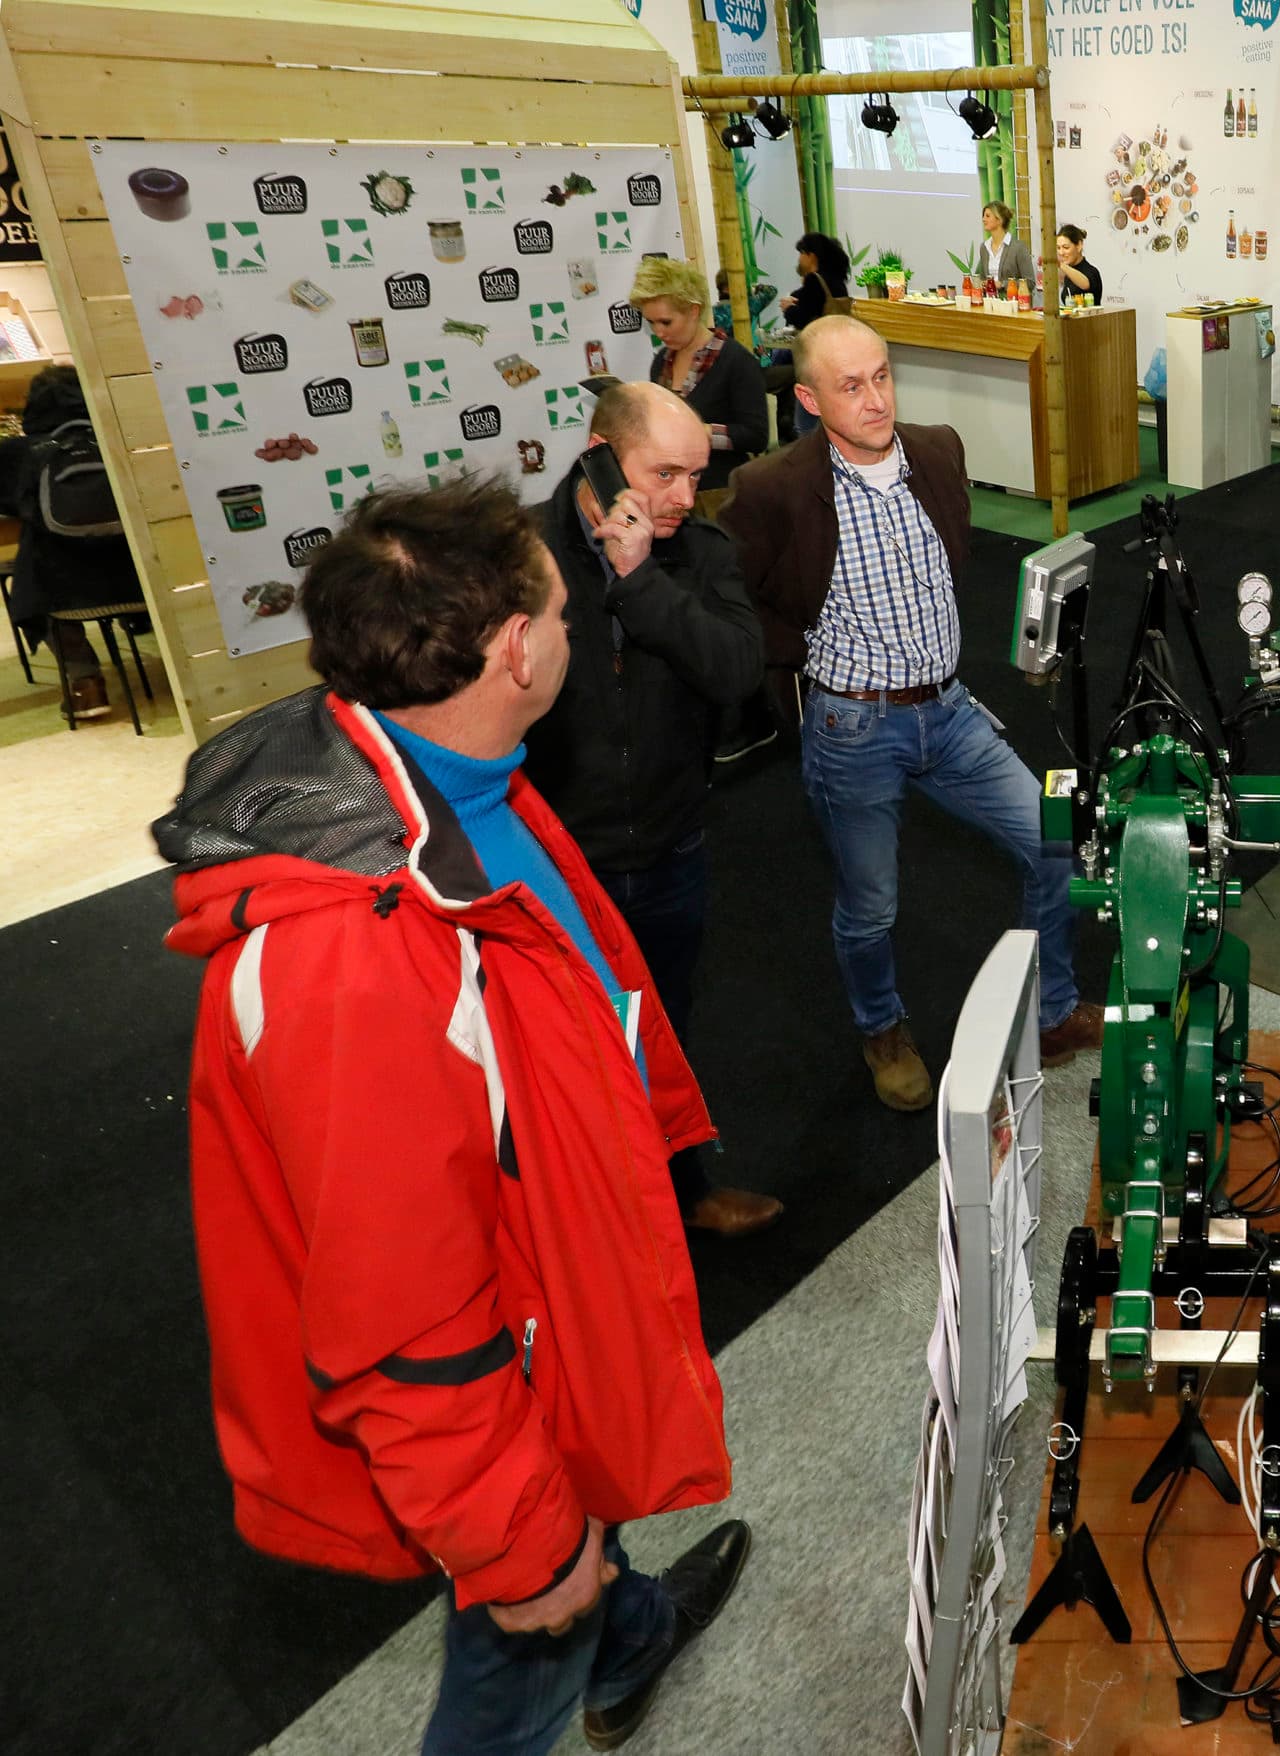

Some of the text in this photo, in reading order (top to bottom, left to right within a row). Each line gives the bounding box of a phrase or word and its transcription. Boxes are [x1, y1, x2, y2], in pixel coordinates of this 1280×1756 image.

[1241, 1, 1272, 20] SANA
[725, 6, 760, 31] SANA
[1072, 27, 1102, 57] HET
[1110, 25, 1153, 56] GOED
[1161, 22, 1187, 54] IS!
[1241, 40, 1274, 53] positive
[725, 50, 768, 67] positive
[1245, 50, 1272, 64] eating
[732, 64, 766, 75] eating
[258, 183, 303, 197] PUUR
[630, 180, 658, 192] PUUR
[261, 195, 304, 206] NOORD
[631, 190, 659, 200] NOORD
[517, 226, 550, 239] PUUR
[519, 237, 551, 247] NOORD
[388, 280, 425, 294] PUUR
[482, 274, 515, 288] PUUR
[391, 291, 428, 301] NOORD
[484, 285, 516, 296] NOORD
[239, 341, 283, 356] PUUR
[241, 352, 284, 366] NOORD
[307, 384, 347, 400] PUUR
[310, 396, 349, 409] NOORD
[463, 411, 497, 426] PUUR
[465, 421, 498, 433] NOORD
[288, 533, 329, 551] PUUR
